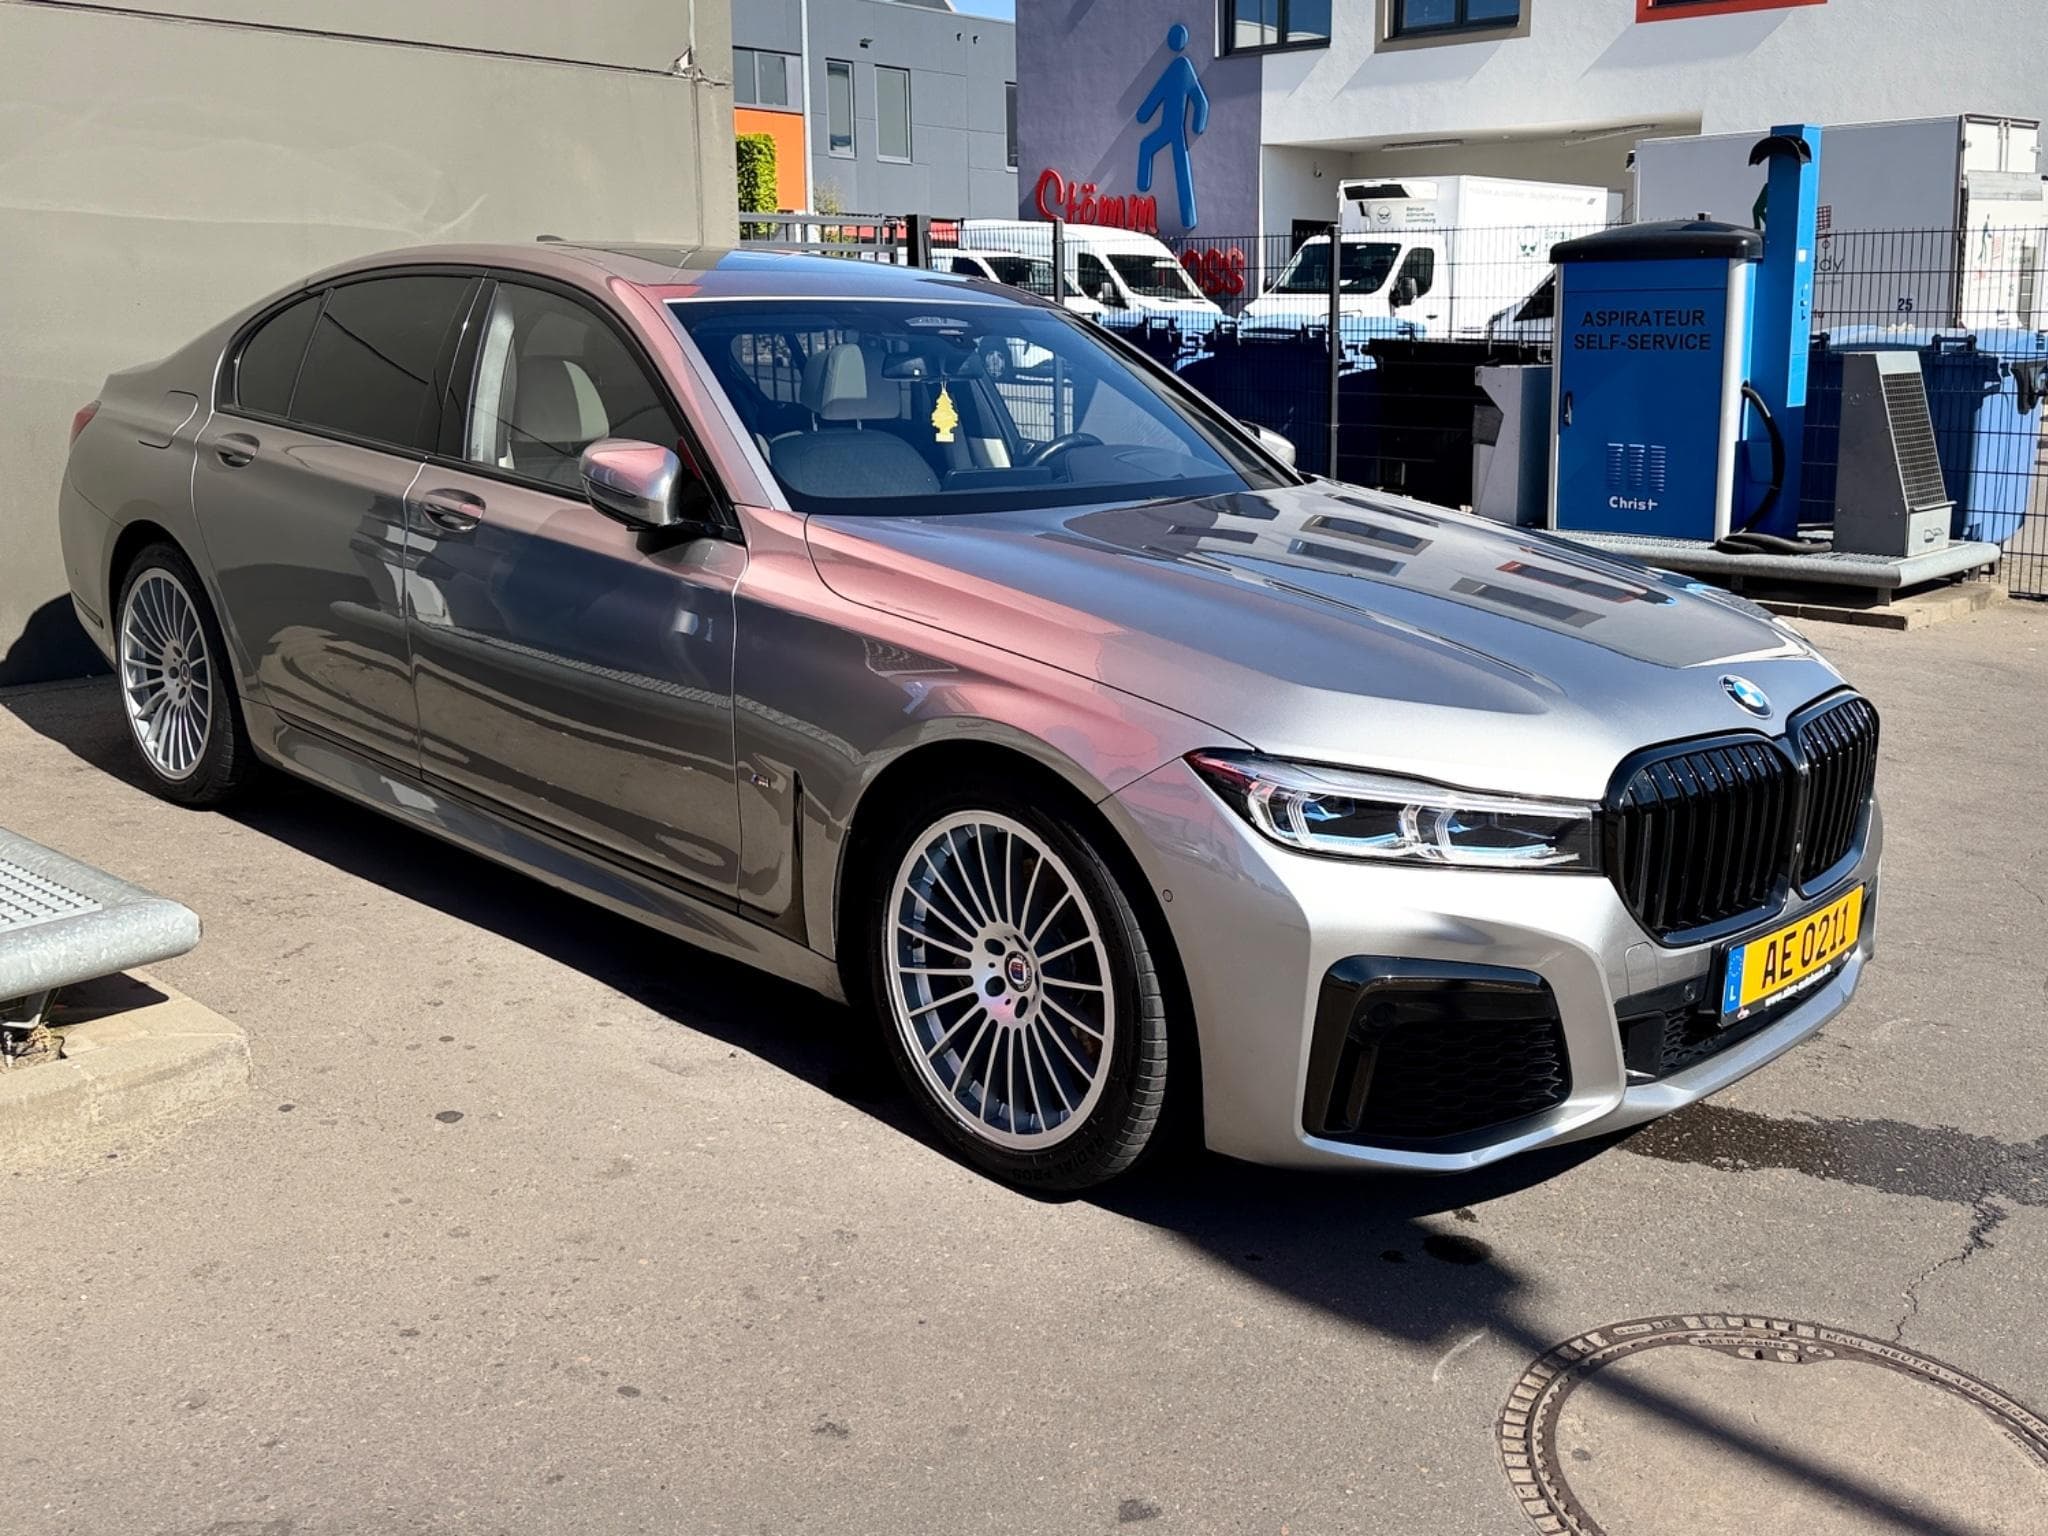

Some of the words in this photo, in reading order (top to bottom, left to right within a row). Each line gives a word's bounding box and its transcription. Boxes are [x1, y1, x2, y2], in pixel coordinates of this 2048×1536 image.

[1897, 297, 1913, 312] 25
[1581, 309, 1705, 327] ASPIRATEUR
[1574, 332, 1712, 351] SELF-SERVICE
[1608, 495, 1659, 511] Christ
[1761, 930, 1797, 990] AE
[1800, 901, 1849, 969] 0211
[1729, 984, 1737, 1002] L
